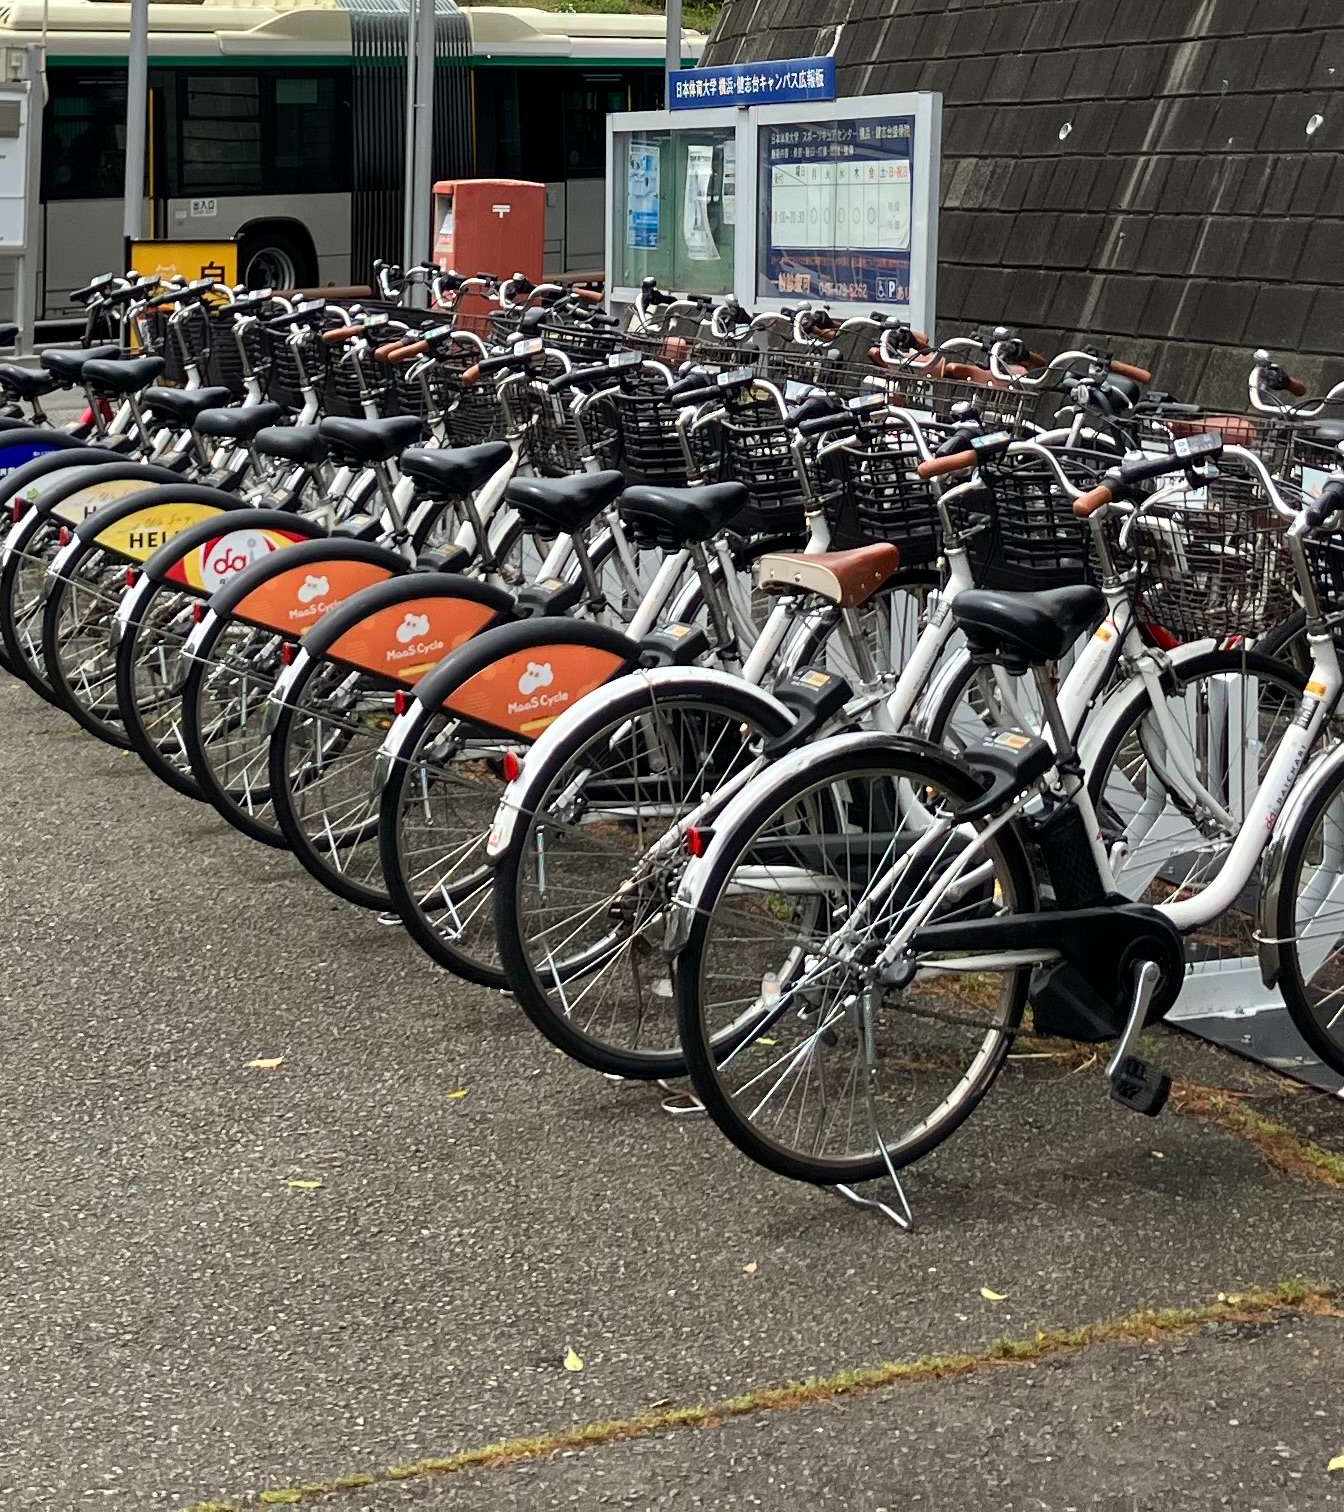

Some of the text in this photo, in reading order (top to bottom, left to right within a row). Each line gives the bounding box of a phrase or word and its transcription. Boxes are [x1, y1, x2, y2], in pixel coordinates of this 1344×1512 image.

[676, 77, 718, 99] 日本体育大学
[386, 639, 445, 661] MaaS Cycle
[507, 690, 569, 715] MaaS Cycle
